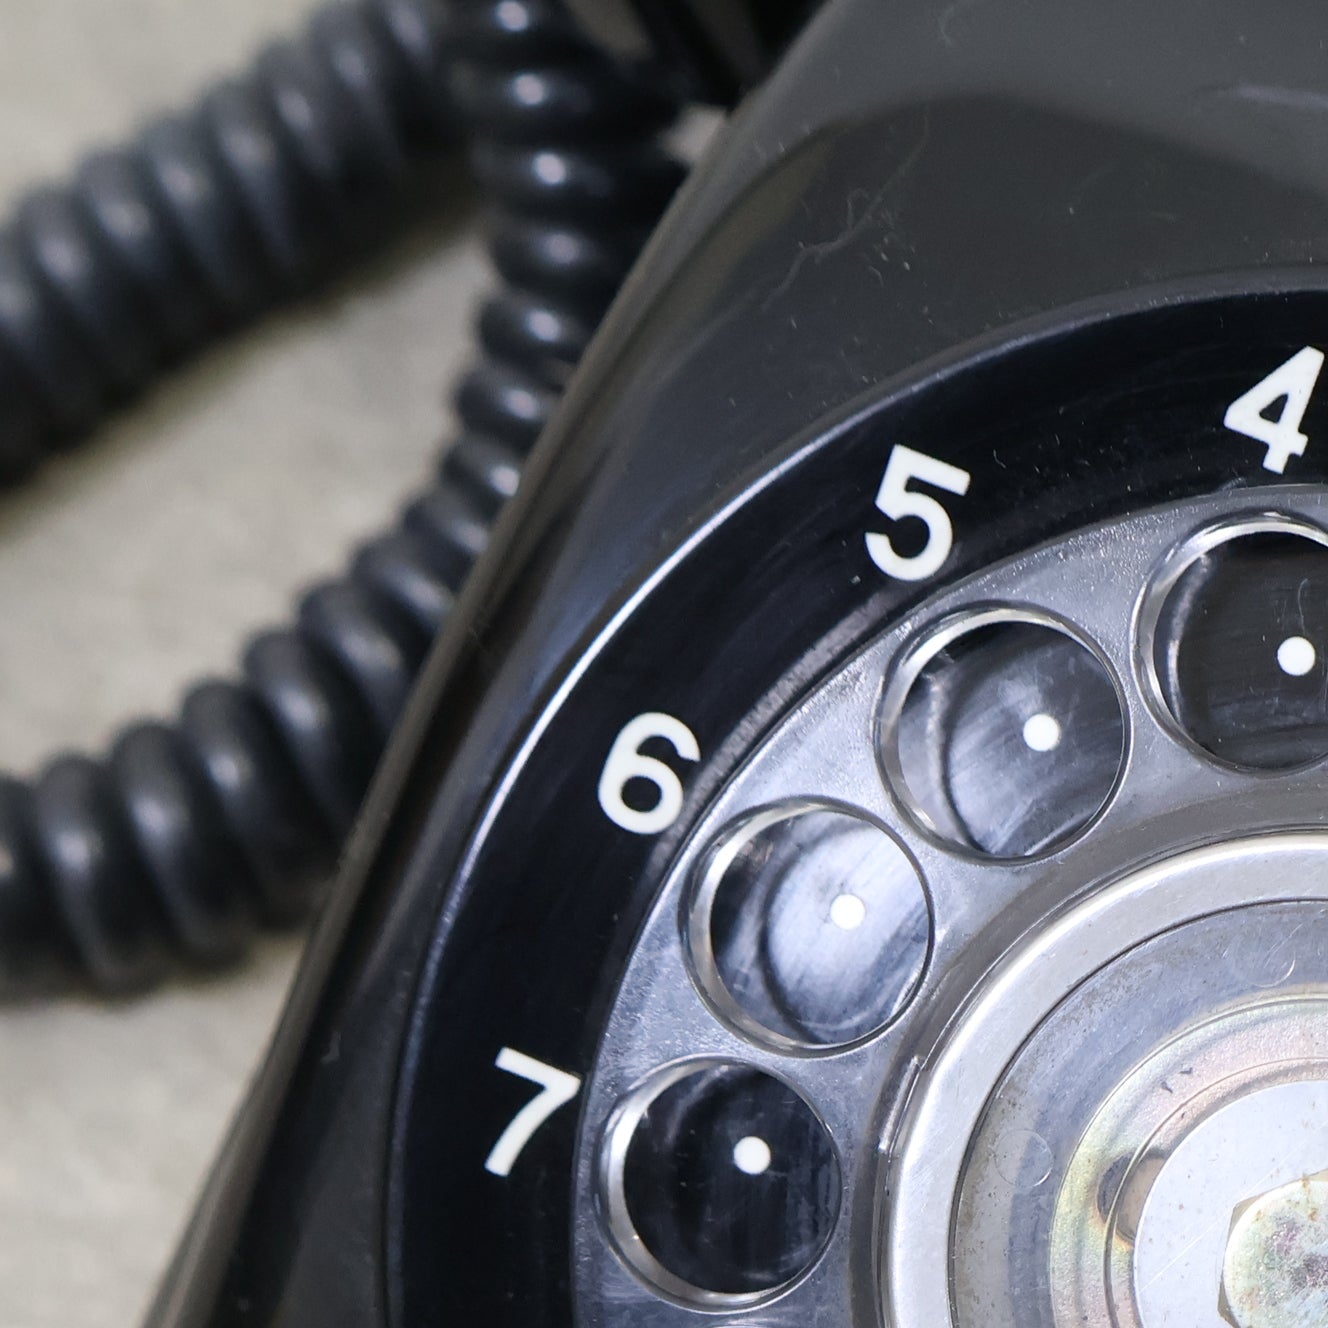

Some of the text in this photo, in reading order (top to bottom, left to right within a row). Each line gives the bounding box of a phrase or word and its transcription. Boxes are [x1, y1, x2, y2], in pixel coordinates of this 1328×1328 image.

[1225, 347, 1324, 473] 4
[866, 446, 970, 580] 5
[599, 713, 699, 833] 6
[487, 1048, 579, 1175] 7
